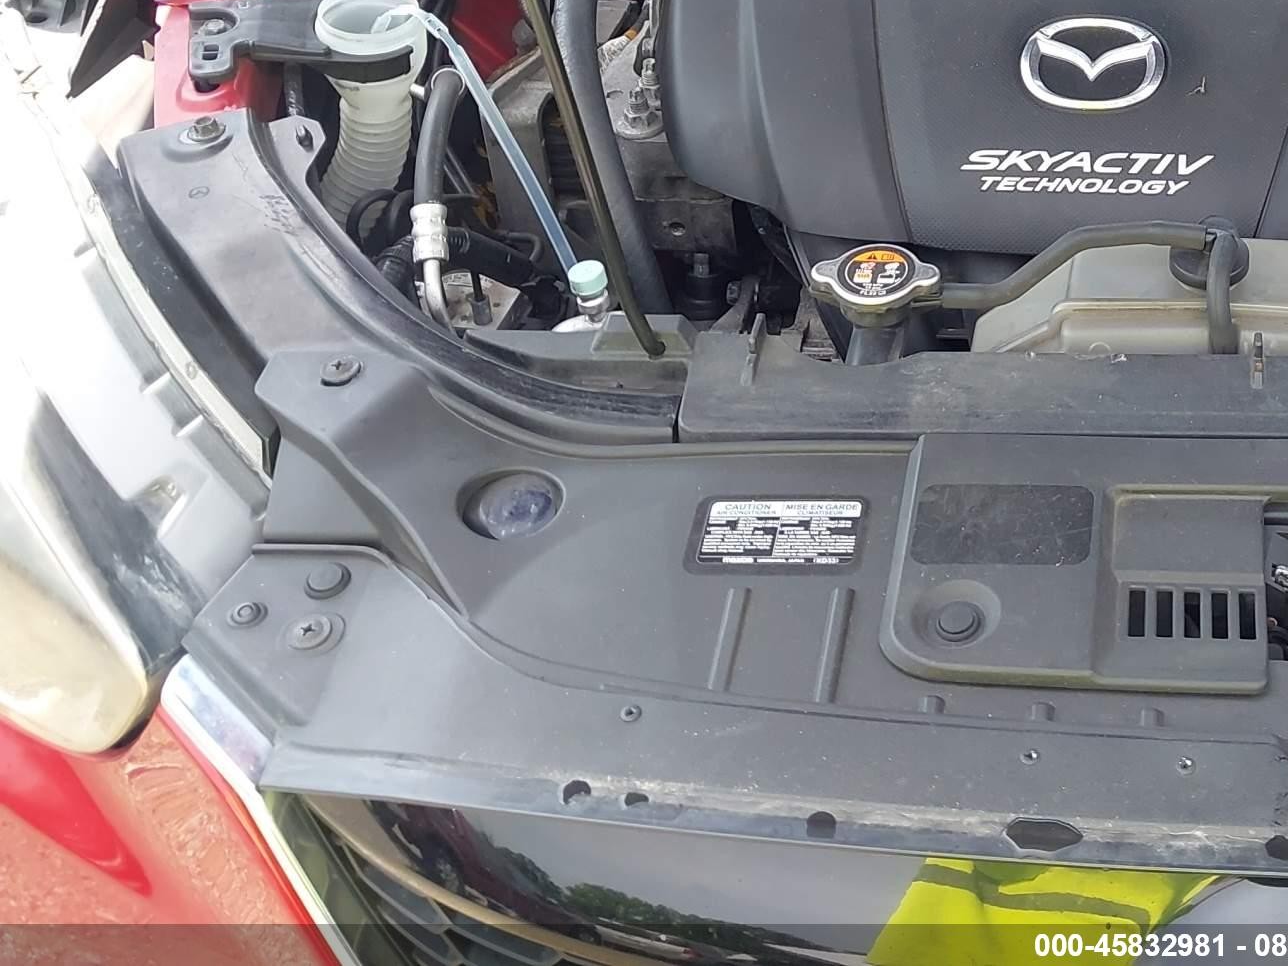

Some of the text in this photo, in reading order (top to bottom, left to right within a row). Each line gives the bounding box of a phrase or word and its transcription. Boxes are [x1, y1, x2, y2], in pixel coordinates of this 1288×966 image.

[960, 149, 1215, 176] SKYACTIV
[980, 176, 1191, 195] TECHNOLOGY
[724, 503, 772, 511] CAUTION
[785, 503, 807, 511] MISE
[810, 503, 823, 511] EN
